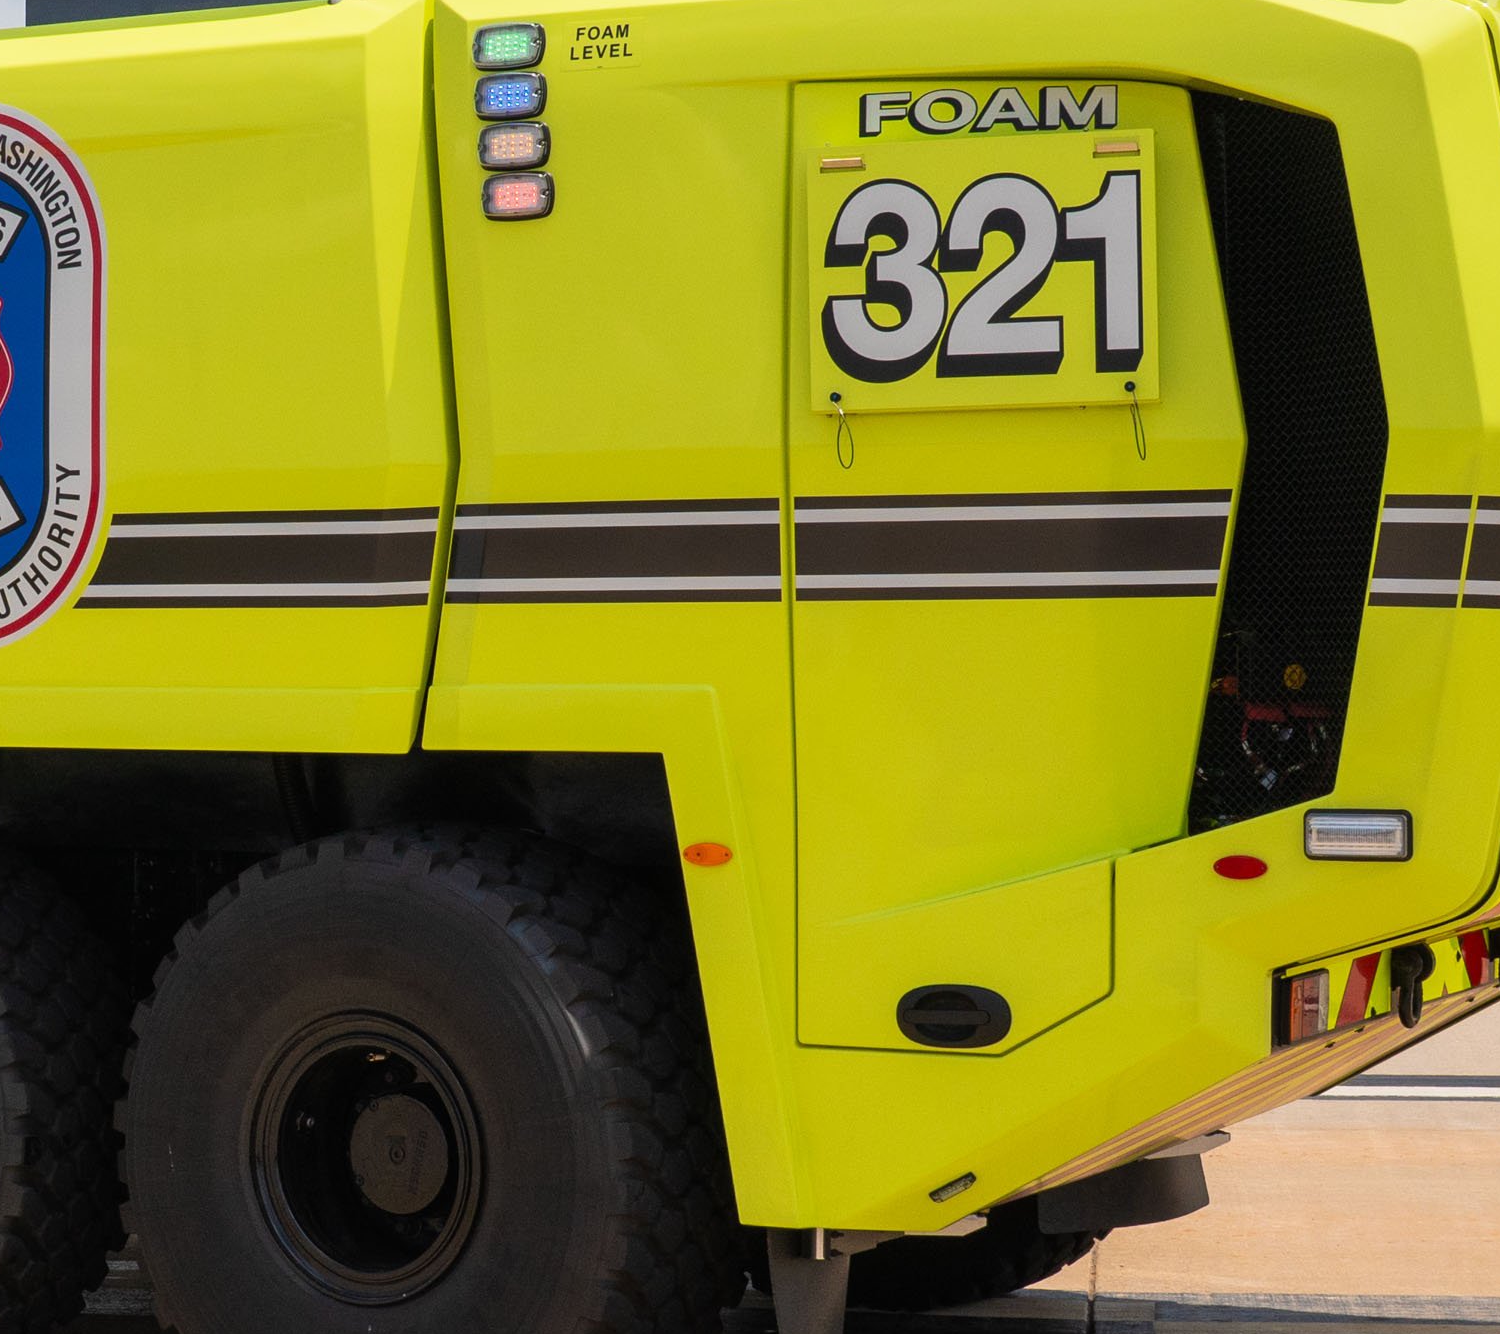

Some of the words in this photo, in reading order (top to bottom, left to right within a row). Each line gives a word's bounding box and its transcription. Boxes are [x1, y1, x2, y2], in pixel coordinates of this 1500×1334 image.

[576, 24, 629, 41] FOAM
[570, 43, 632, 60] LEVEL
[859, 85, 1118, 138] FOAM
[821, 169, 1144, 384] 321
